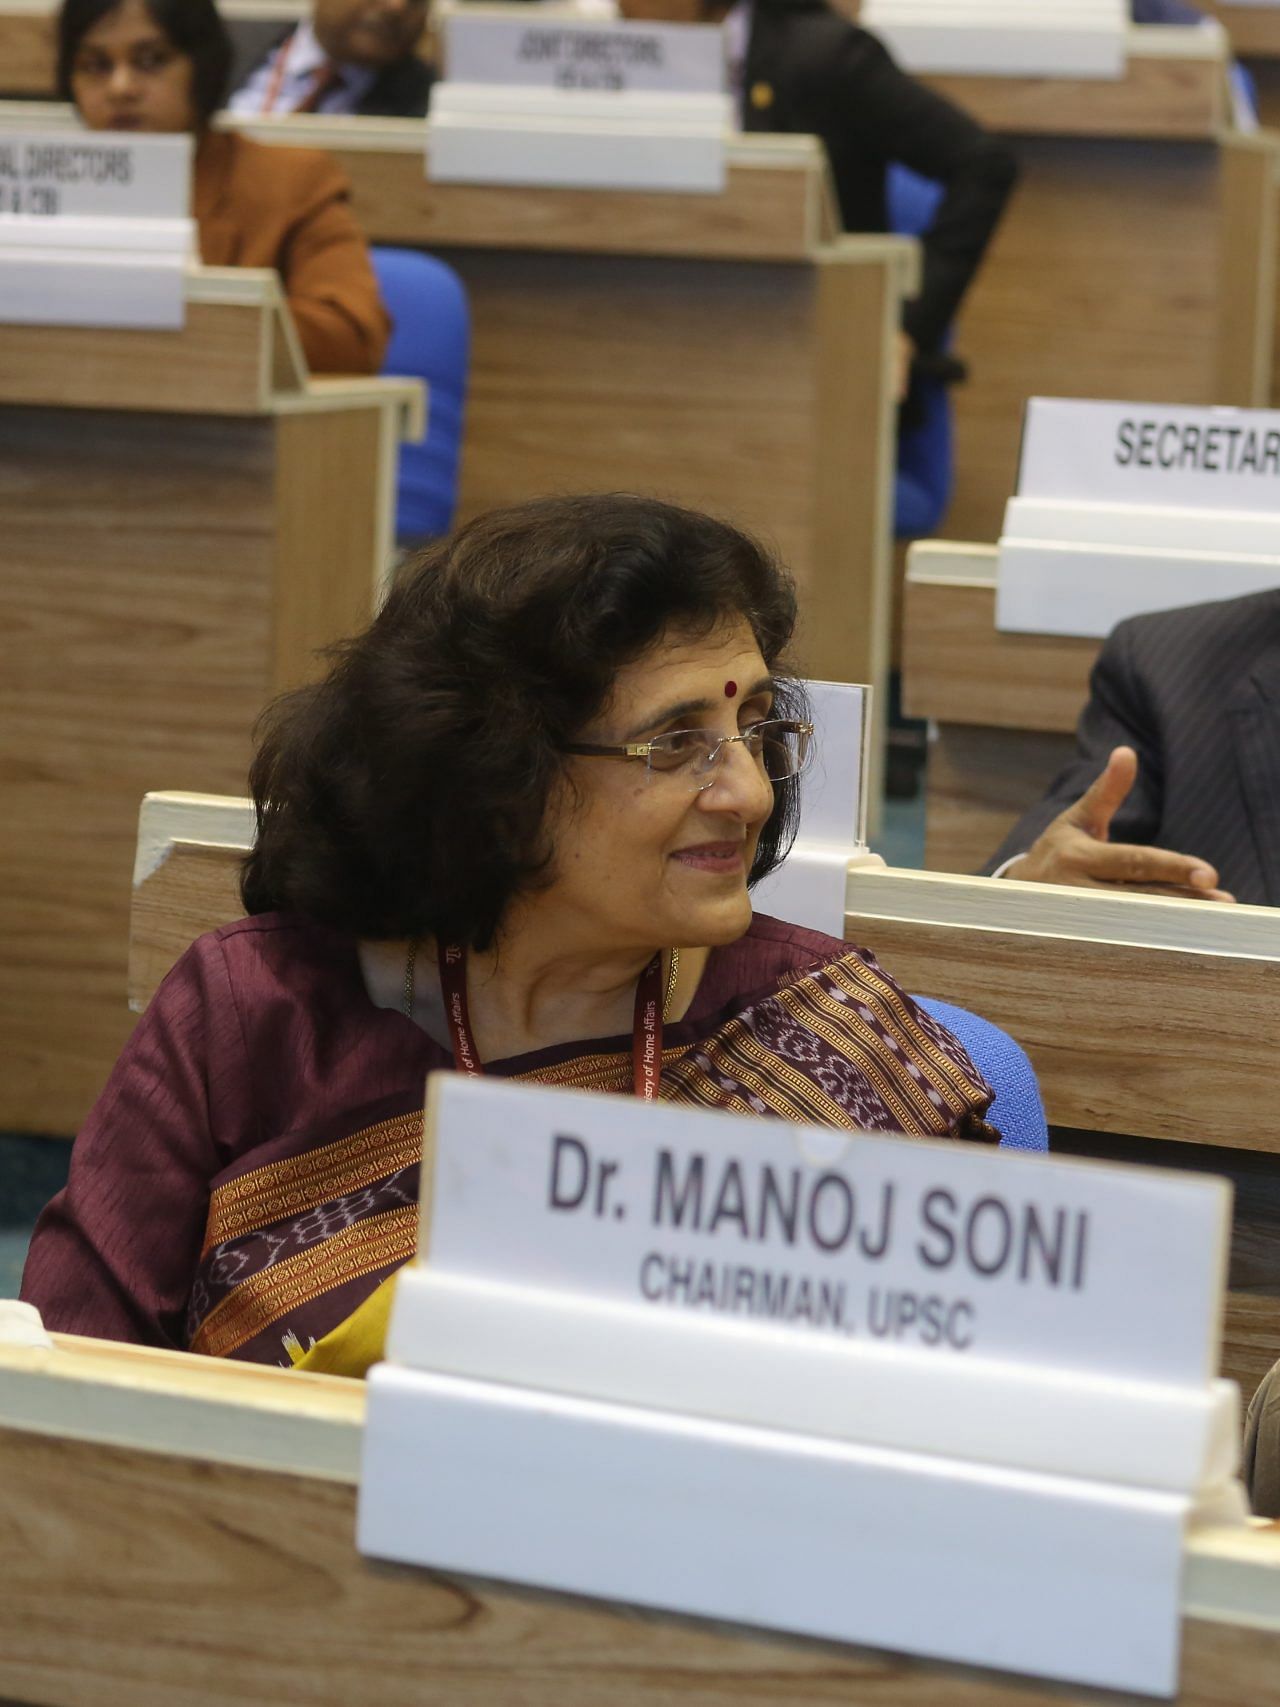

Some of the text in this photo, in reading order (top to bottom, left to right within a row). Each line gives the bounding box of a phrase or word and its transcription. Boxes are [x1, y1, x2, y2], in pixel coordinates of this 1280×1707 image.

[452, 992, 464, 1025] Affairs
[643, 1000, 656, 1032] Affairs
[457, 1026, 471, 1057] Home
[643, 1033, 655, 1064] Home
[462, 1057, 474, 1069] of
[642, 1064, 654, 1079] of
[548, 1134, 1090, 1293] Dr. MANOJ SONI
[868, 1290, 977, 1350] UPSC
